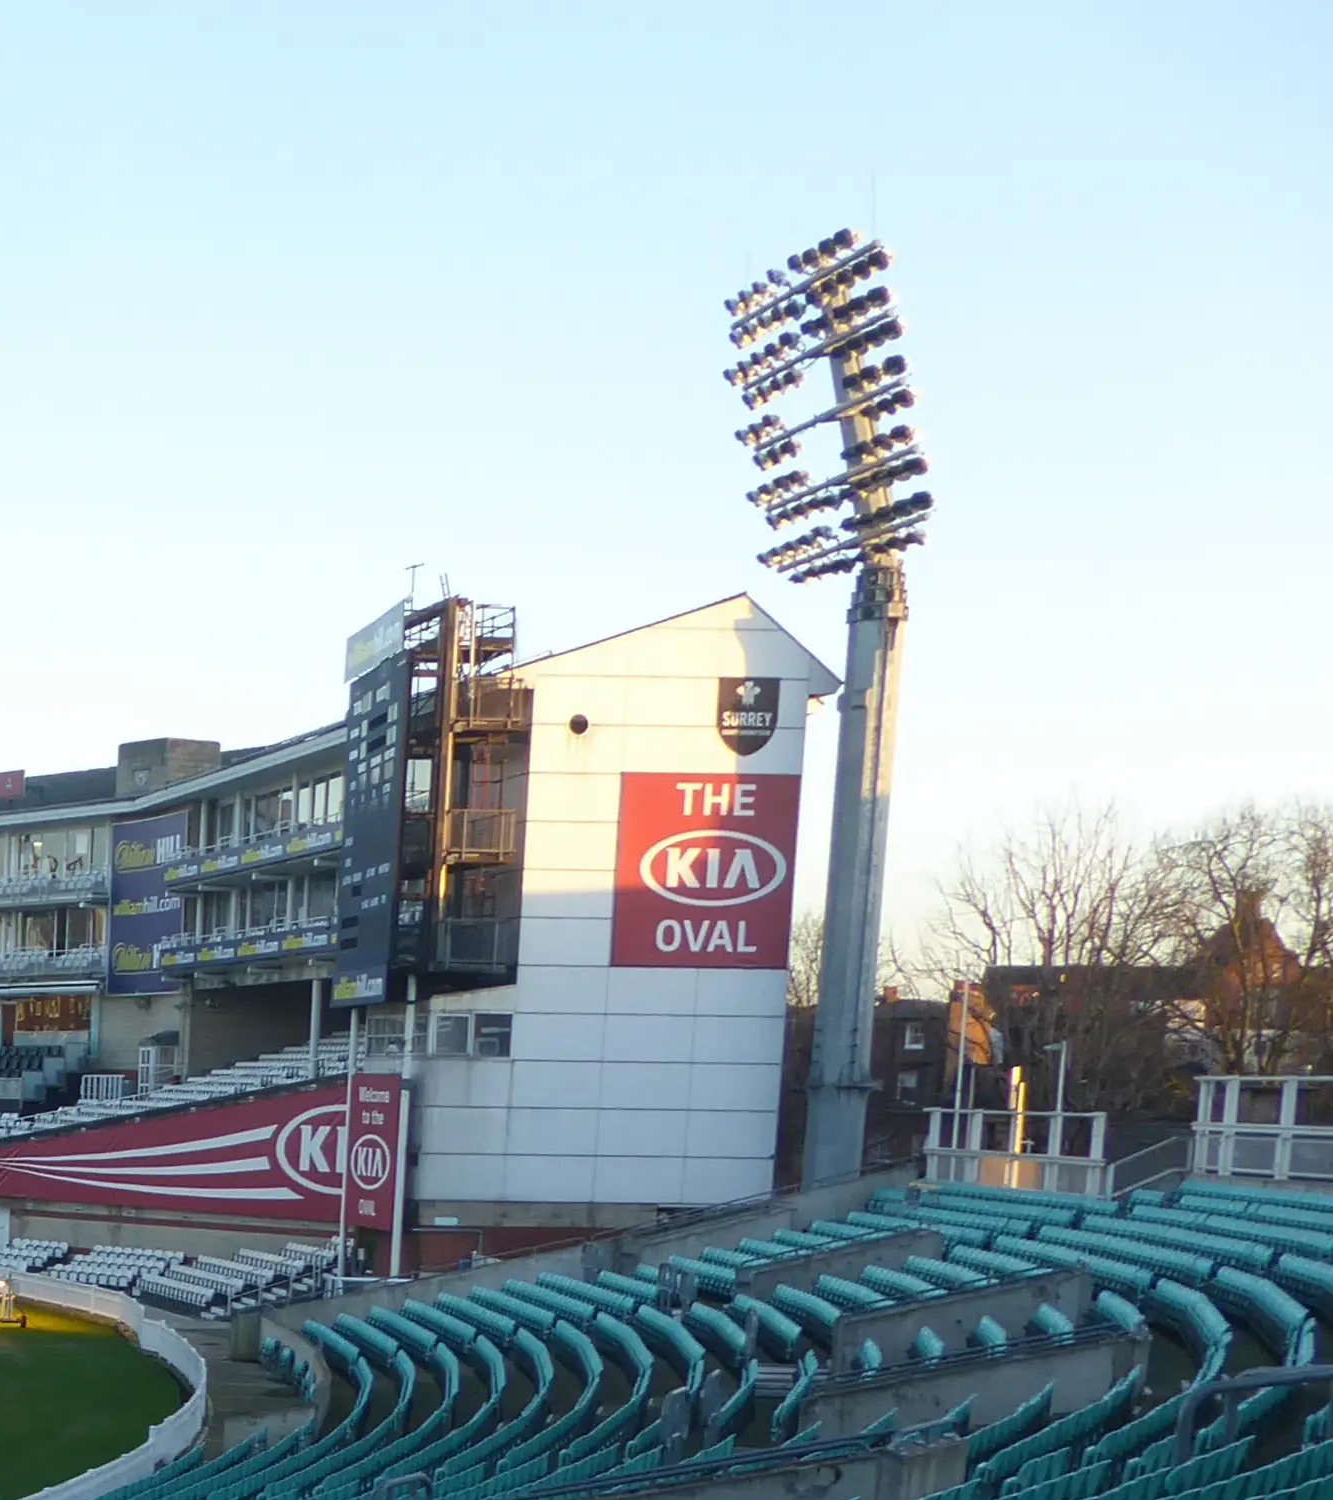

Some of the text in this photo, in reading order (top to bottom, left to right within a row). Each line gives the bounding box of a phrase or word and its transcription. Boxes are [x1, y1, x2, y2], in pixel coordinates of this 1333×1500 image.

[722, 711, 773, 727] SURREY
[676, 783, 757, 816] THE
[665, 847, 761, 889] KIA
[655, 919, 757, 953] OVAL
[359, 1086, 390, 1103] Welcome
[371, 1109, 385, 1125] the
[357, 1146, 383, 1177] KIA
